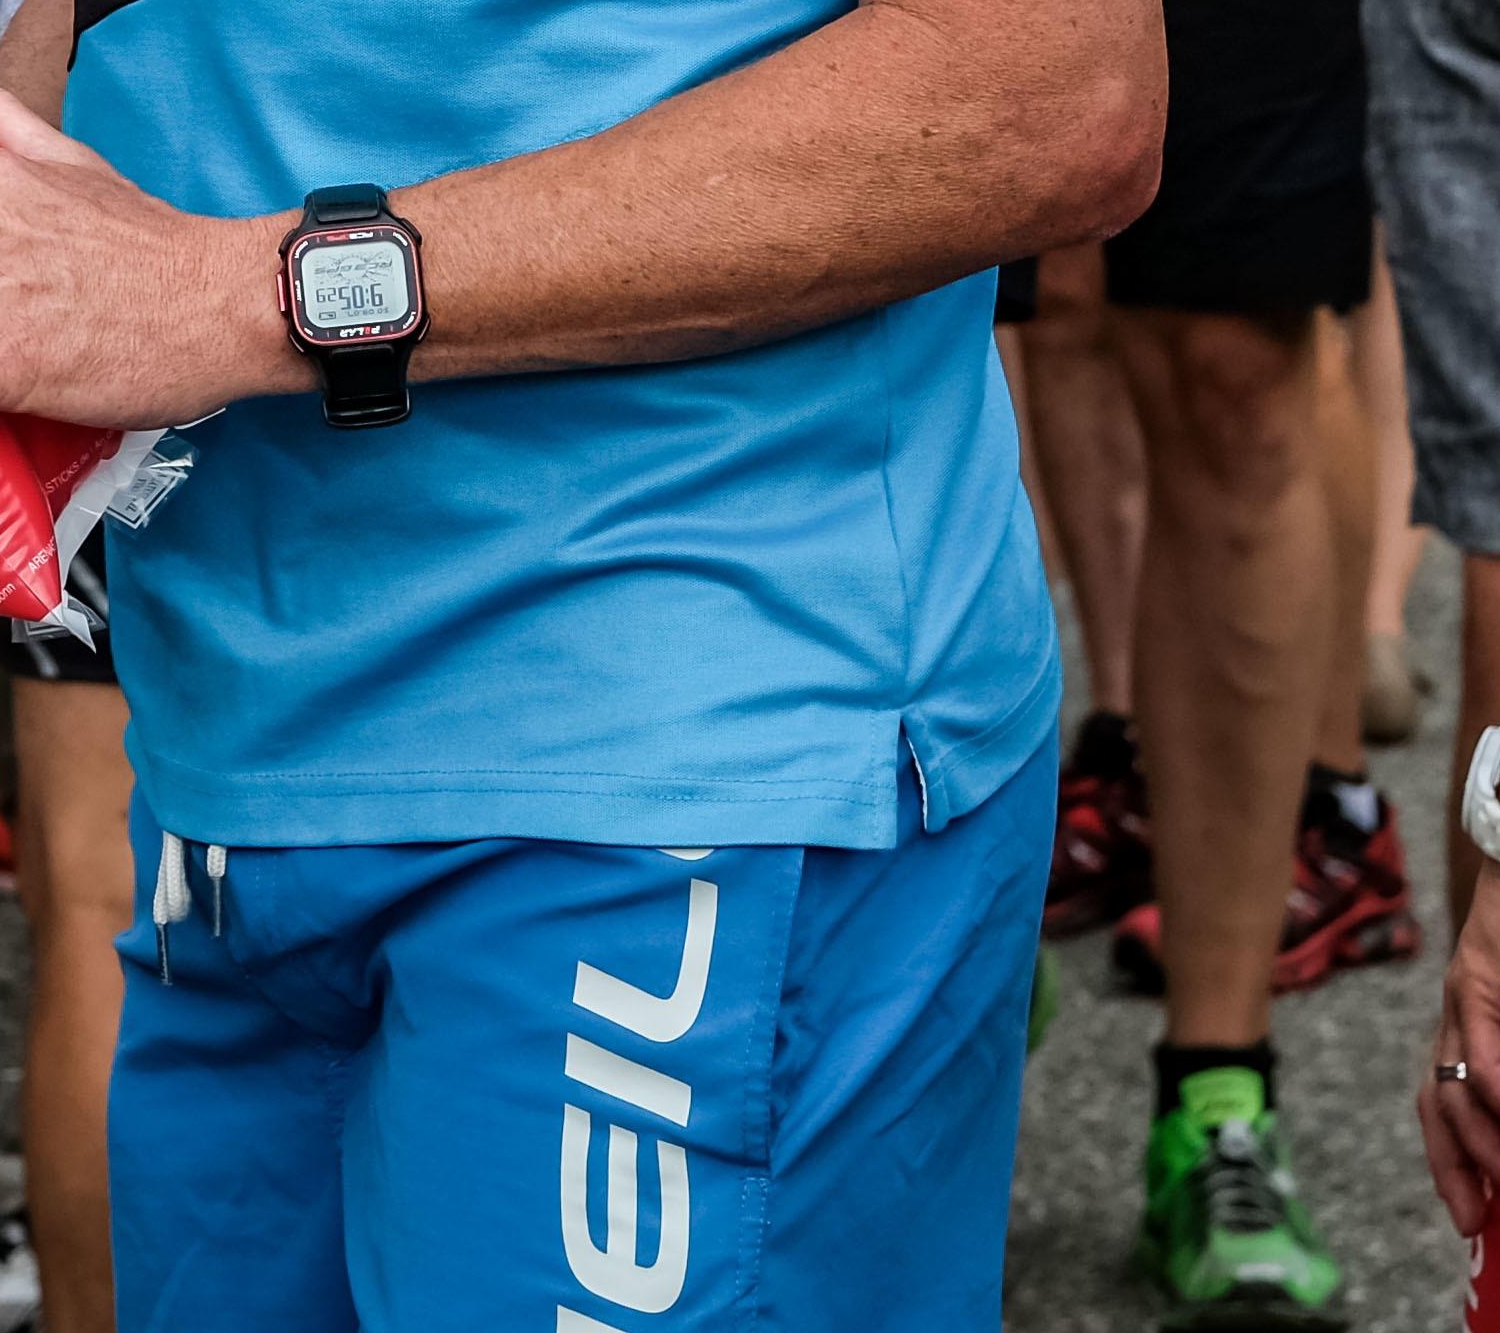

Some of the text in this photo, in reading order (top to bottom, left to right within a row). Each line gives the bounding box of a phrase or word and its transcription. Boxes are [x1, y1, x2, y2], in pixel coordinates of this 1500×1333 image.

[315, 287, 338, 304] 29
[338, 282, 385, 311] 9:05
[339, 325, 381, 338] POLAR
[556, 848, 719, 1333] EIL
